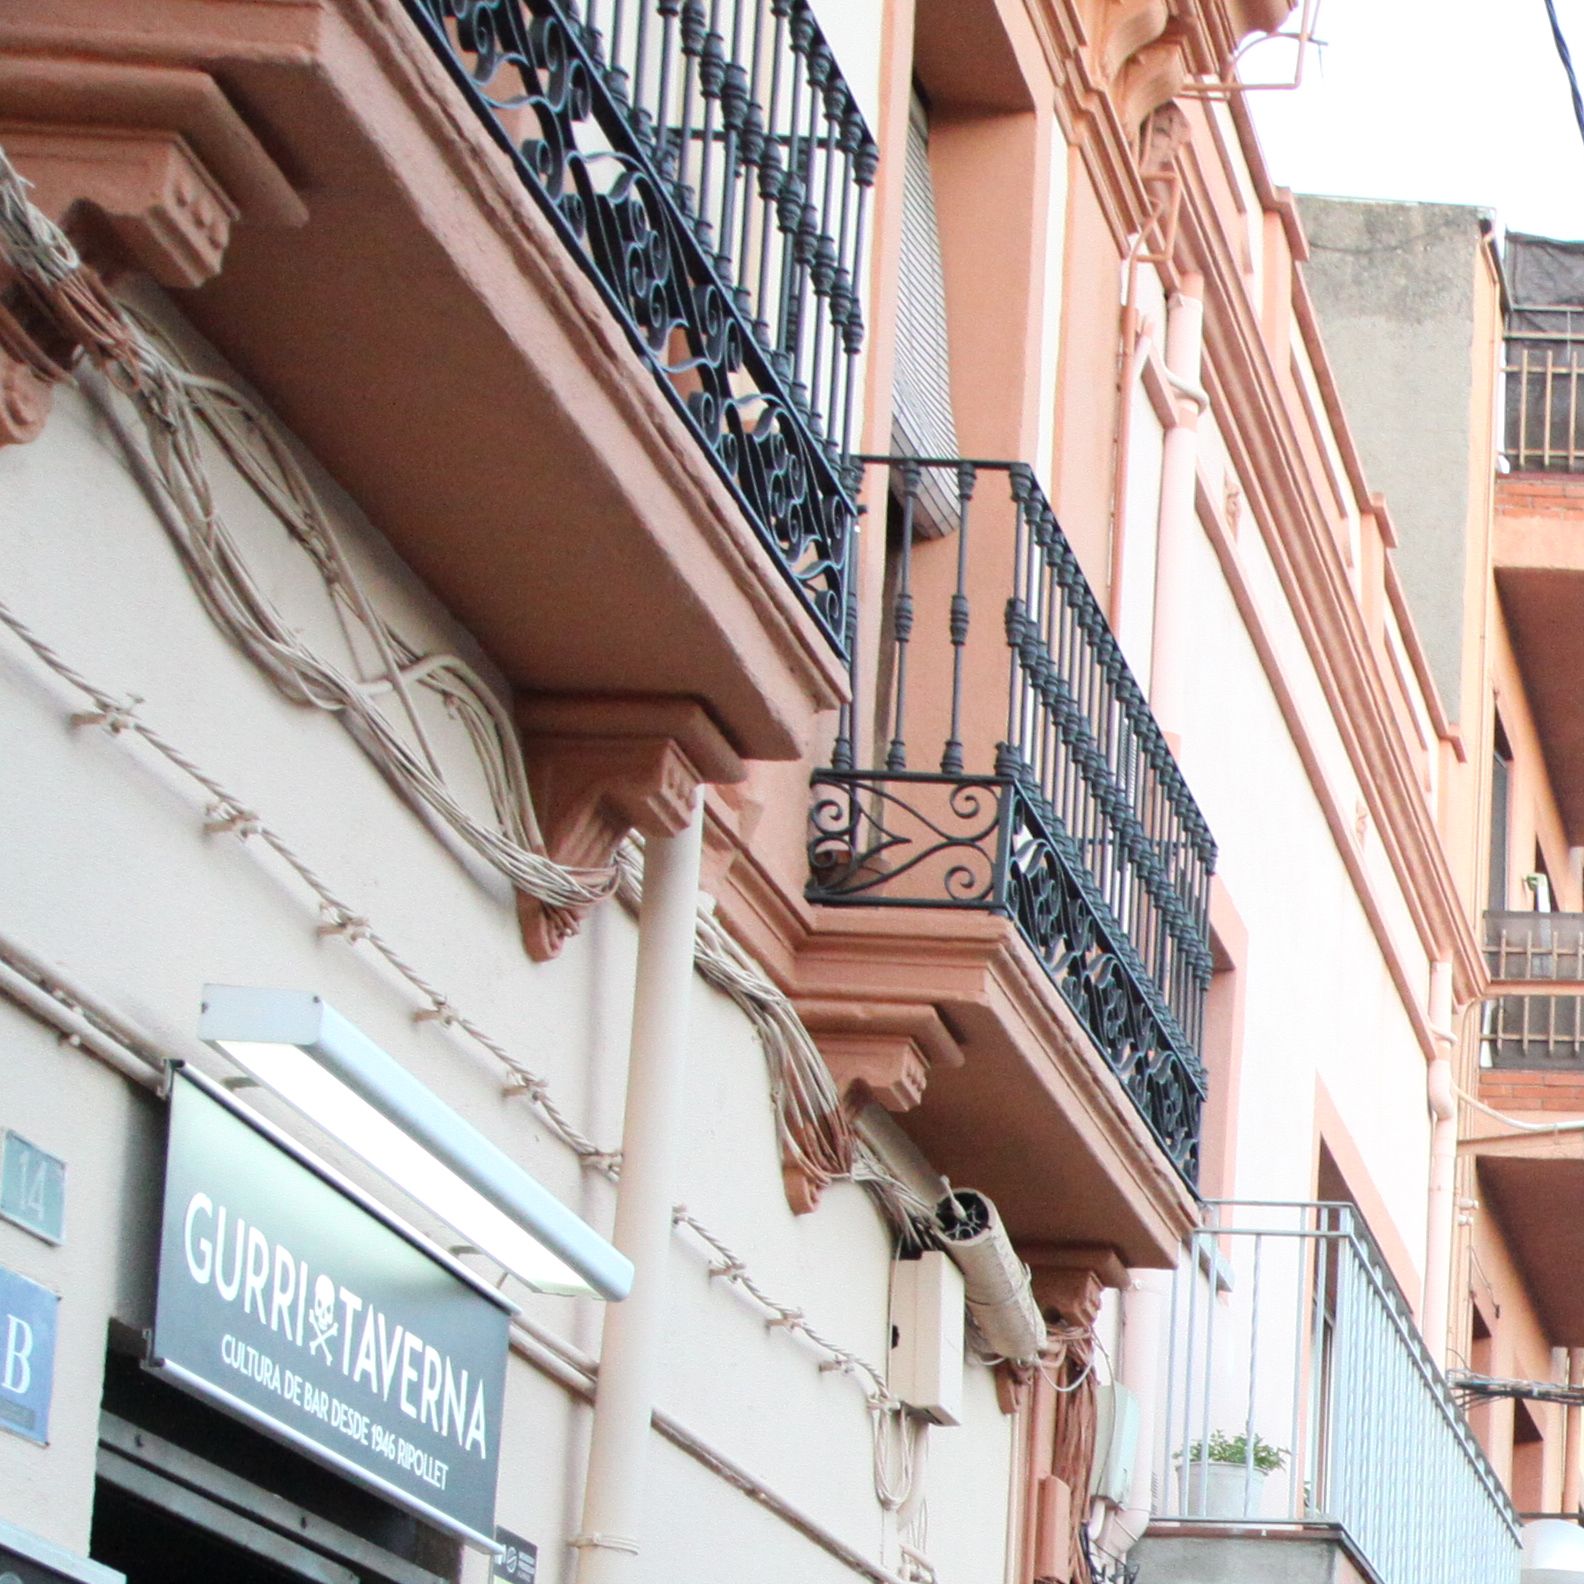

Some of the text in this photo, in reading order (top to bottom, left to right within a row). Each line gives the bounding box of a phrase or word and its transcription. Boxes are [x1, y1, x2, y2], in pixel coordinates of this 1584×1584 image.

[2, 1313, 33, 1394] B
[185, 1192, 487, 1460] GURRI TAVERNA
[221, 1334, 449, 1491] CULTURA DE BAR DESDE 1946 RIPOLLET
